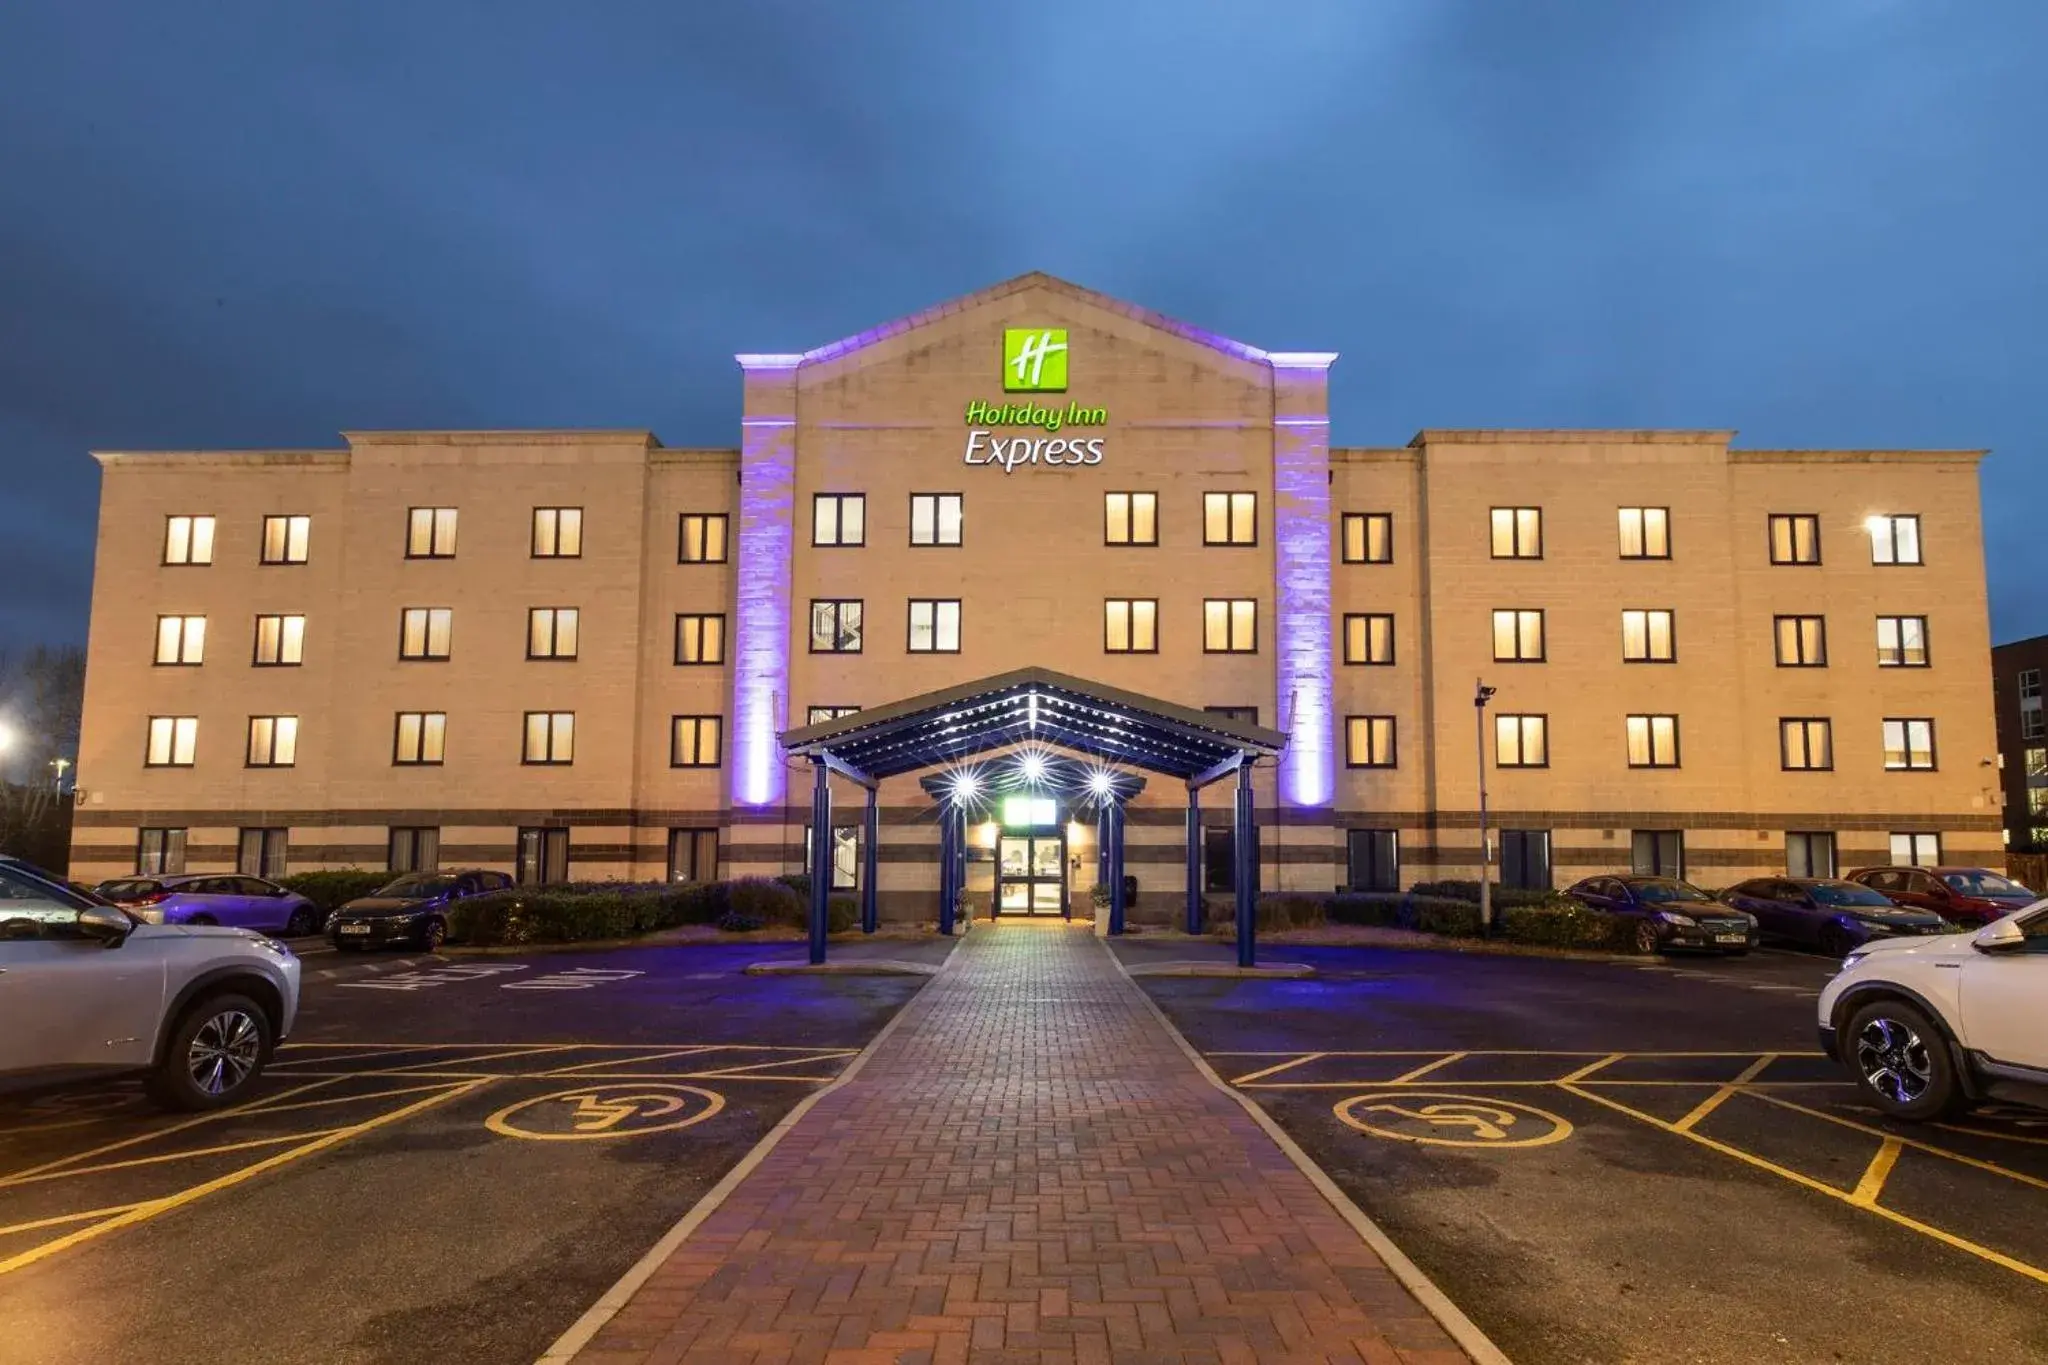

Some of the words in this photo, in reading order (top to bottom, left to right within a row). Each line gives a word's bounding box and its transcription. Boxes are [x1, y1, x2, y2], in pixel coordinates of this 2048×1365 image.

[966, 400, 1063, 432] Holiday
[1066, 400, 1107, 425] Inn
[964, 430, 1105, 474] Express
[500, 967, 646, 990] ONLY
